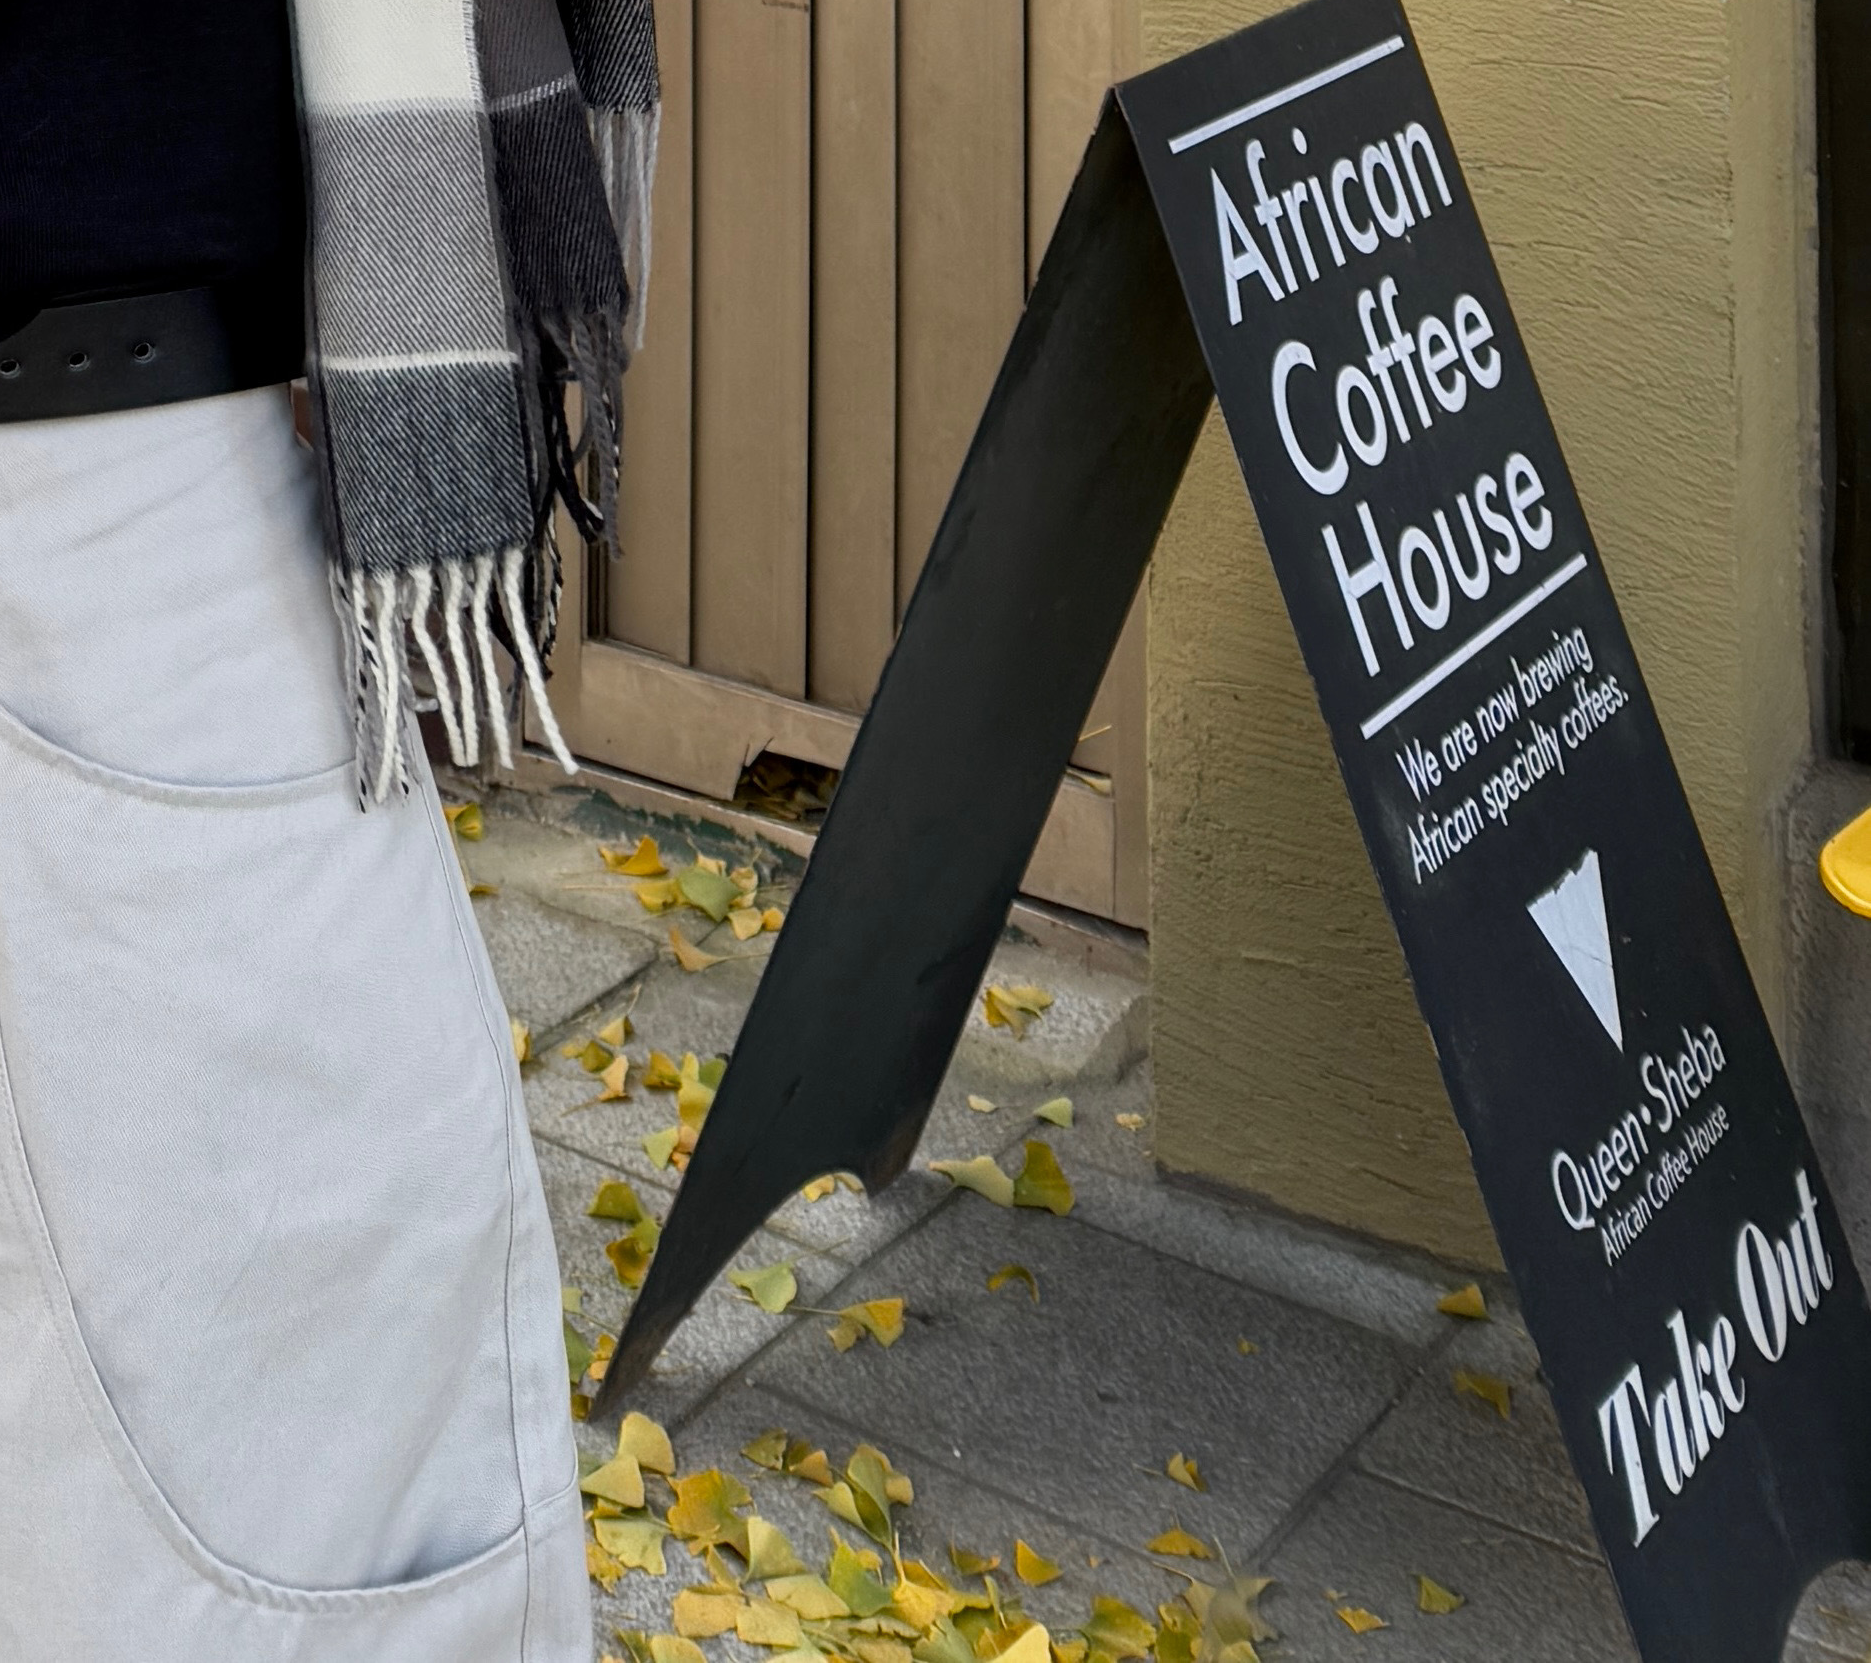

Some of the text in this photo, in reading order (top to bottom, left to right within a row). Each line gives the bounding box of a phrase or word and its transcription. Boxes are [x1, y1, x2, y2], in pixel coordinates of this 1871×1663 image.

[1210, 120, 1453, 326] African
[1270, 276, 1503, 496] Coffee
[1321, 451, 1554, 678] House
[1394, 626, 1594, 803] We are now brewing
[1406, 674, 1630, 885] African specialty coffees.
[1599, 1102, 1730, 1267] African Coffee House
[1596, 1167, 1834, 1549] Take Out
